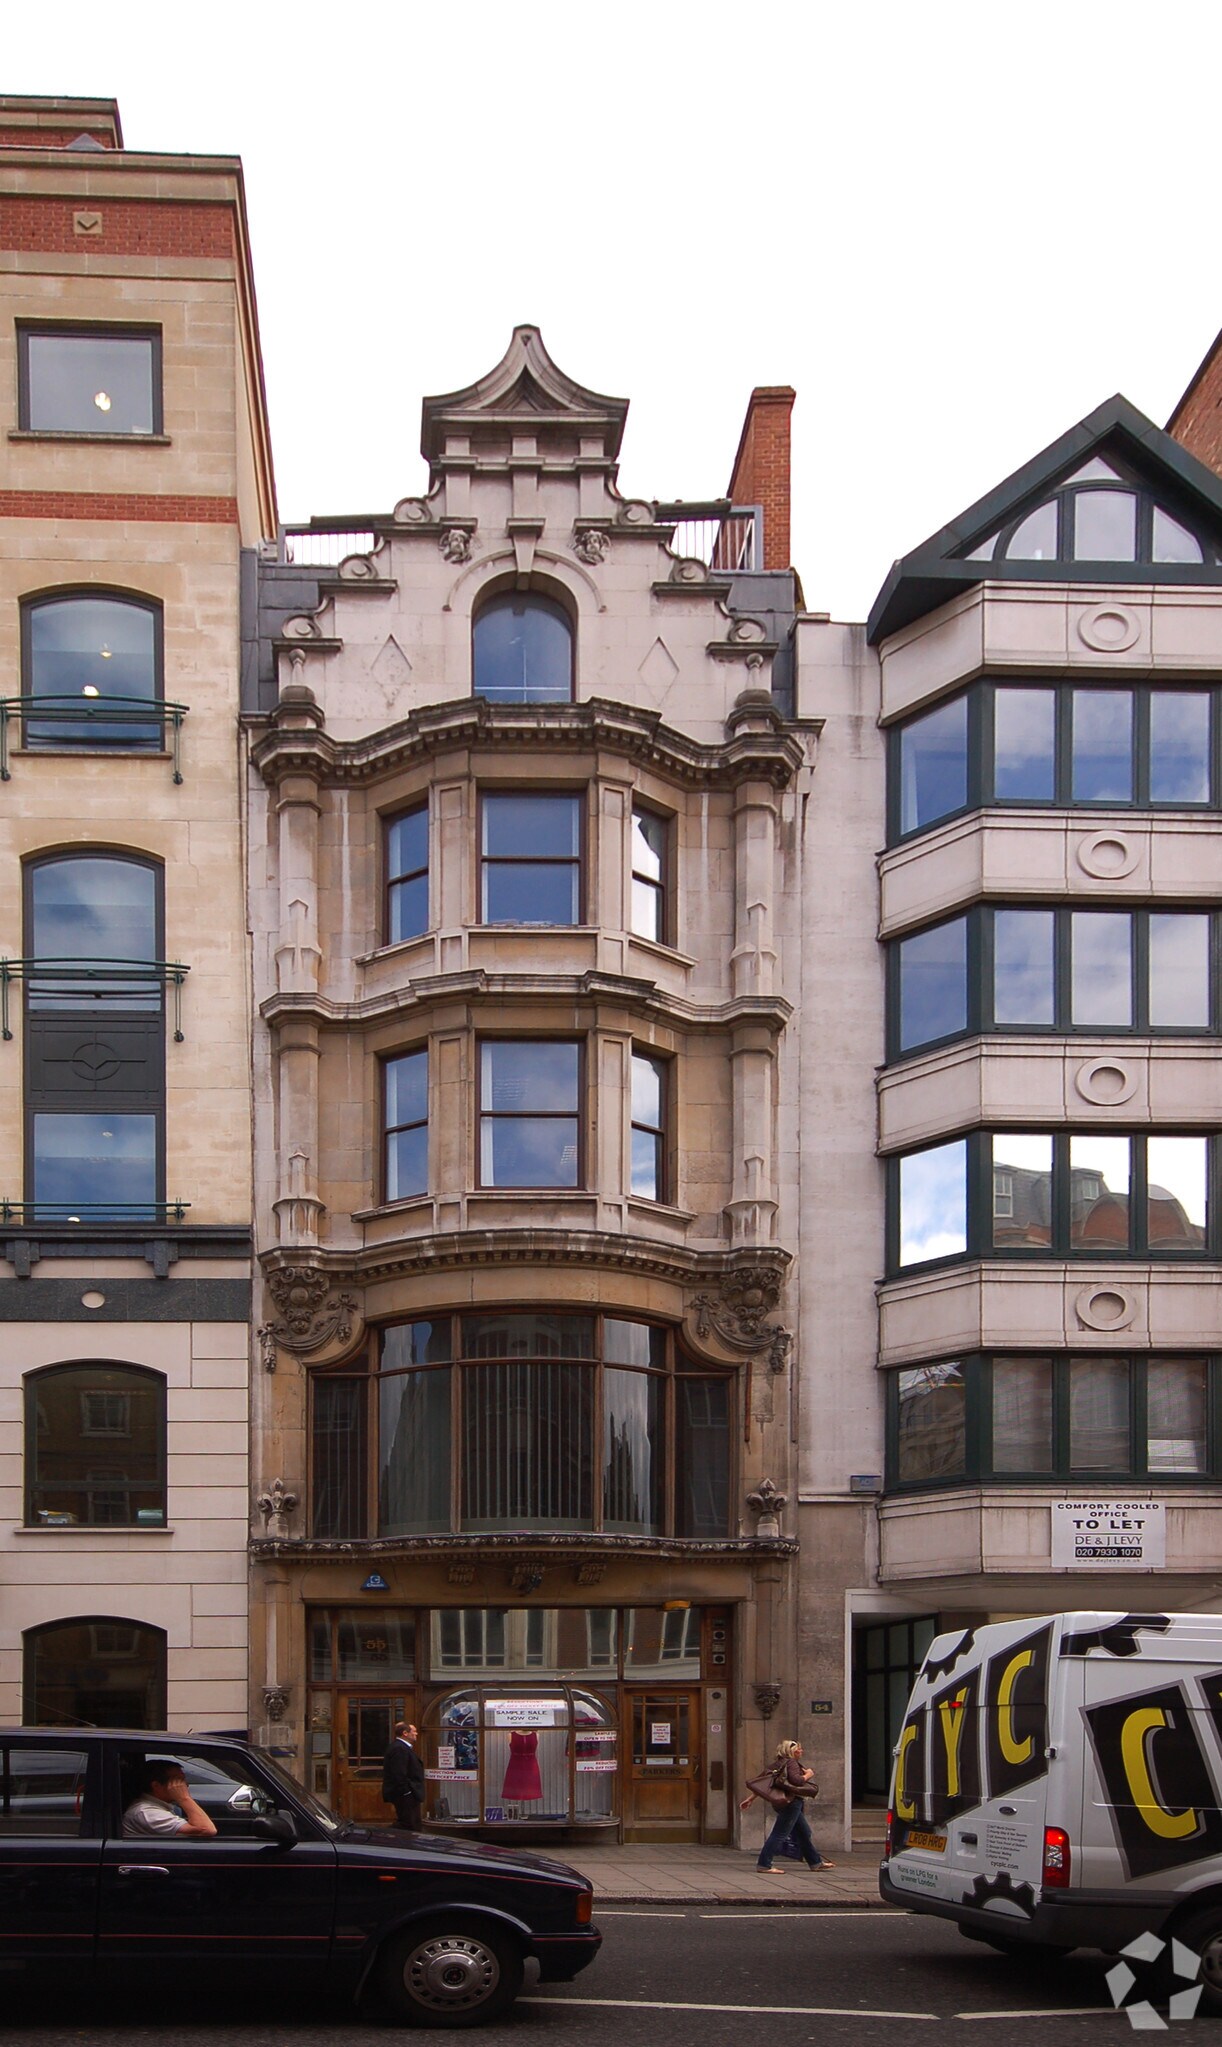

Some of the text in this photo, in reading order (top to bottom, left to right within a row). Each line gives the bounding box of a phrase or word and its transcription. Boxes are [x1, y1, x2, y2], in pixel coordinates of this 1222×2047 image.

[1072, 1520, 1145, 1530] TO LET
[1075, 1536, 1091, 1545] DE
[1095, 1536, 1103, 1545] &
[1114, 1536, 1143, 1545] LEVY
[1076, 1548, 1142, 1556] 020 7930 1070
[366, 1640, 386, 1650] 55
[897, 1650, 1035, 1821] CYC
[909, 1832, 944, 1849] LR08 HRG
[915, 1869, 926, 1878] LPG
[917, 1877, 937, 1888] London
